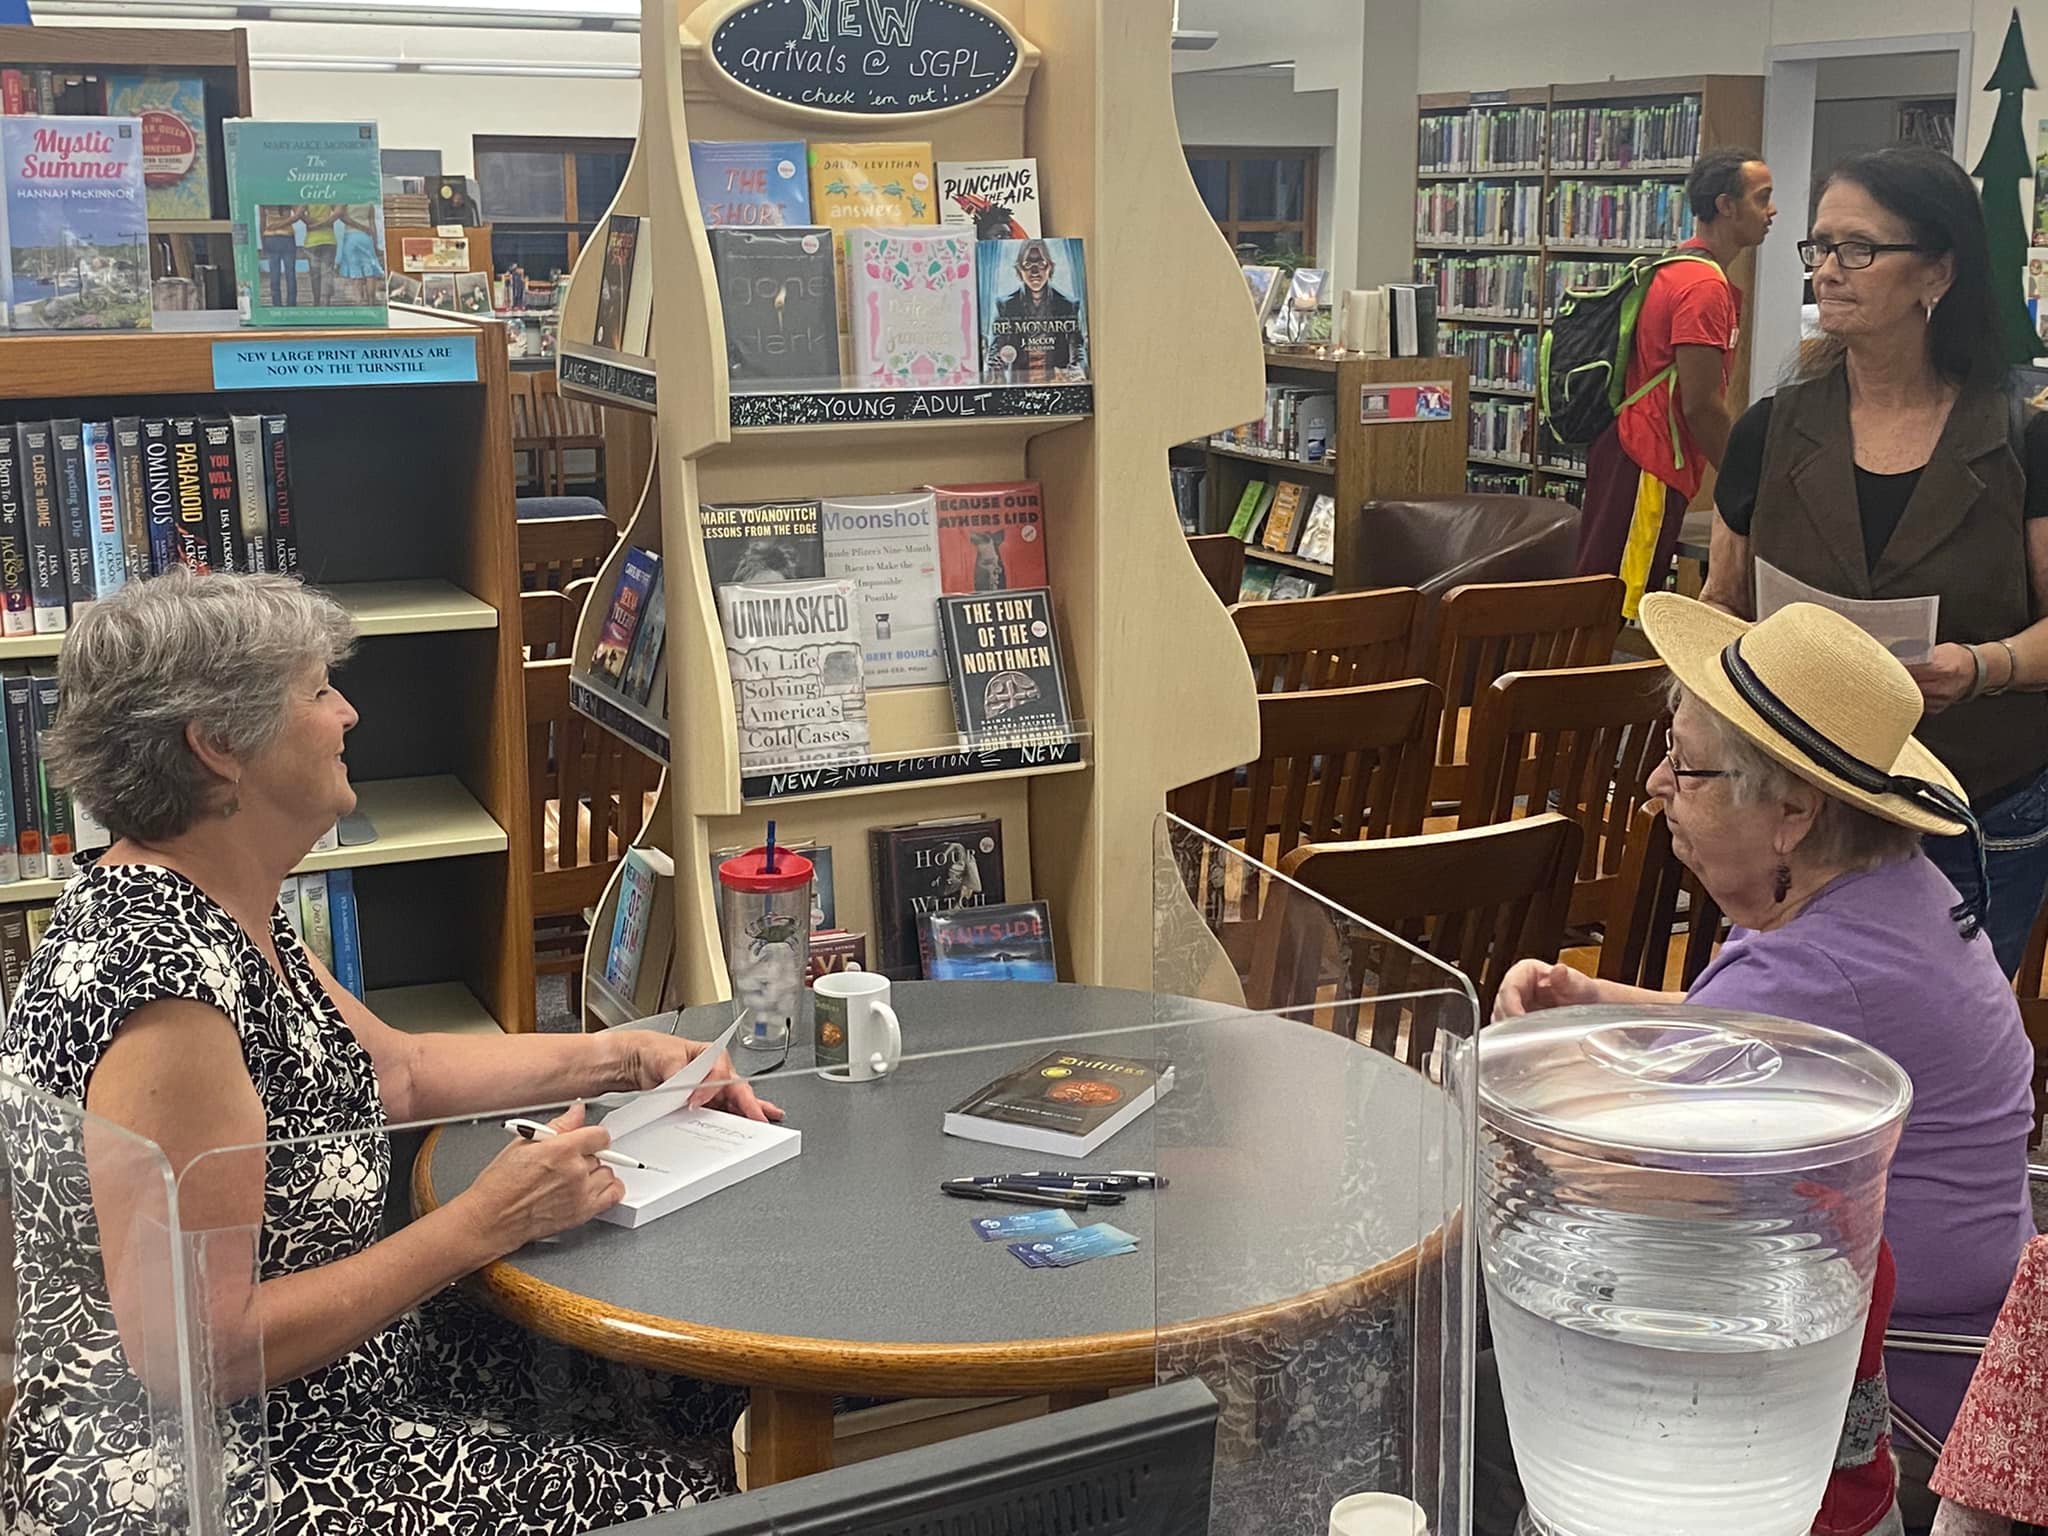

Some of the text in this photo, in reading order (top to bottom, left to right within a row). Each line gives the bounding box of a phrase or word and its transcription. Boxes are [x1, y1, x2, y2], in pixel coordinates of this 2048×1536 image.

[802, 0, 921, 47] NEW
[741, 40, 995, 77] arrivals @ SGPL
[801, 84, 948, 106] check 'em out!
[34, 128, 114, 160] Mystic
[21, 154, 128, 179] Summer
[306, 155, 327, 167] The
[824, 160, 921, 170] DAVID LEVITHAN
[288, 167, 348, 182] Summer
[726, 168, 768, 193] THE
[944, 169, 1032, 199] PUNCHING
[16, 188, 135, 200] HANNAH McKINNON
[300, 184, 336, 200] Girls
[984, 187, 1035, 205] THE AIR
[831, 203, 902, 219] answers
[730, 277, 829, 305] gone
[237, 347, 453, 363] NEW LARGE PRINT ARRIVALS ARE
[267, 361, 425, 376] NOW ON THE TURNSTILE
[817, 396, 896, 418] YOUNG
[912, 392, 993, 417] ADULT
[131, 455, 139, 482] Never
[209, 455, 229, 467] YOU
[94, 443, 115, 534] ONE LAST BREATH
[147, 443, 174, 525] OMINOUS
[175, 443, 203, 523] PARANOID
[209, 471, 232, 484] WILL
[273, 440, 290, 527] WILLING TO DIE
[32, 454, 51, 527] CLOSE HOME
[65, 458, 83, 537] Expecting to Die
[133, 488, 142, 504] Die
[212, 488, 231, 500] PAY
[243, 450, 257, 530] WICKED WAYS
[3, 502, 16, 523] Die
[940, 495, 1039, 511] ECAUSE OUR
[701, 507, 817, 525] MARIE YOVANOVITCH
[823, 508, 929, 532] Moonshot
[938, 512, 1039, 528] ATHERS LIED
[219, 509, 234, 572] LISA JACKSON
[745, 525, 771, 537] FROM
[774, 524, 791, 536] THE
[794, 523, 818, 535] EDGE
[1, 536, 19, 588] JACKSON
[35, 544, 49, 588] JACKSON
[50, 554, 58, 576] LISA
[68, 548, 80, 584] JACKSON
[80, 548, 88, 566] LISA
[104, 542, 116, 584] JACKSON
[128, 544, 139, 577] JACKSO
[140, 554, 148, 573] LISA
[182, 535, 198, 576] JACKSO
[198, 545, 209, 567] LISA
[288, 547, 297, 567] LISA
[844, 563, 863, 573] Race
[876, 561, 898, 571] Make
[901, 560, 913, 569] the
[864, 593, 898, 602] Possible
[732, 594, 849, 640] UNMASKED
[963, 599, 1033, 625] THE FURY
[977, 624, 1029, 648] OF THE
[744, 652, 816, 677] My Life
[866, 649, 938, 662] BERT BOURLA
[963, 646, 1051, 675] NORTHMEN
[744, 680, 818, 700] Solving
[750, 700, 840, 723] America's
[749, 727, 850, 748] Cold Cases
[768, 770, 822, 797] NEW
[1021, 744, 1068, 764] NEW
[915, 849, 976, 869] HOUR
[911, 893, 986, 914] WITCH
[1057, 1056, 1146, 1077] Driftless
